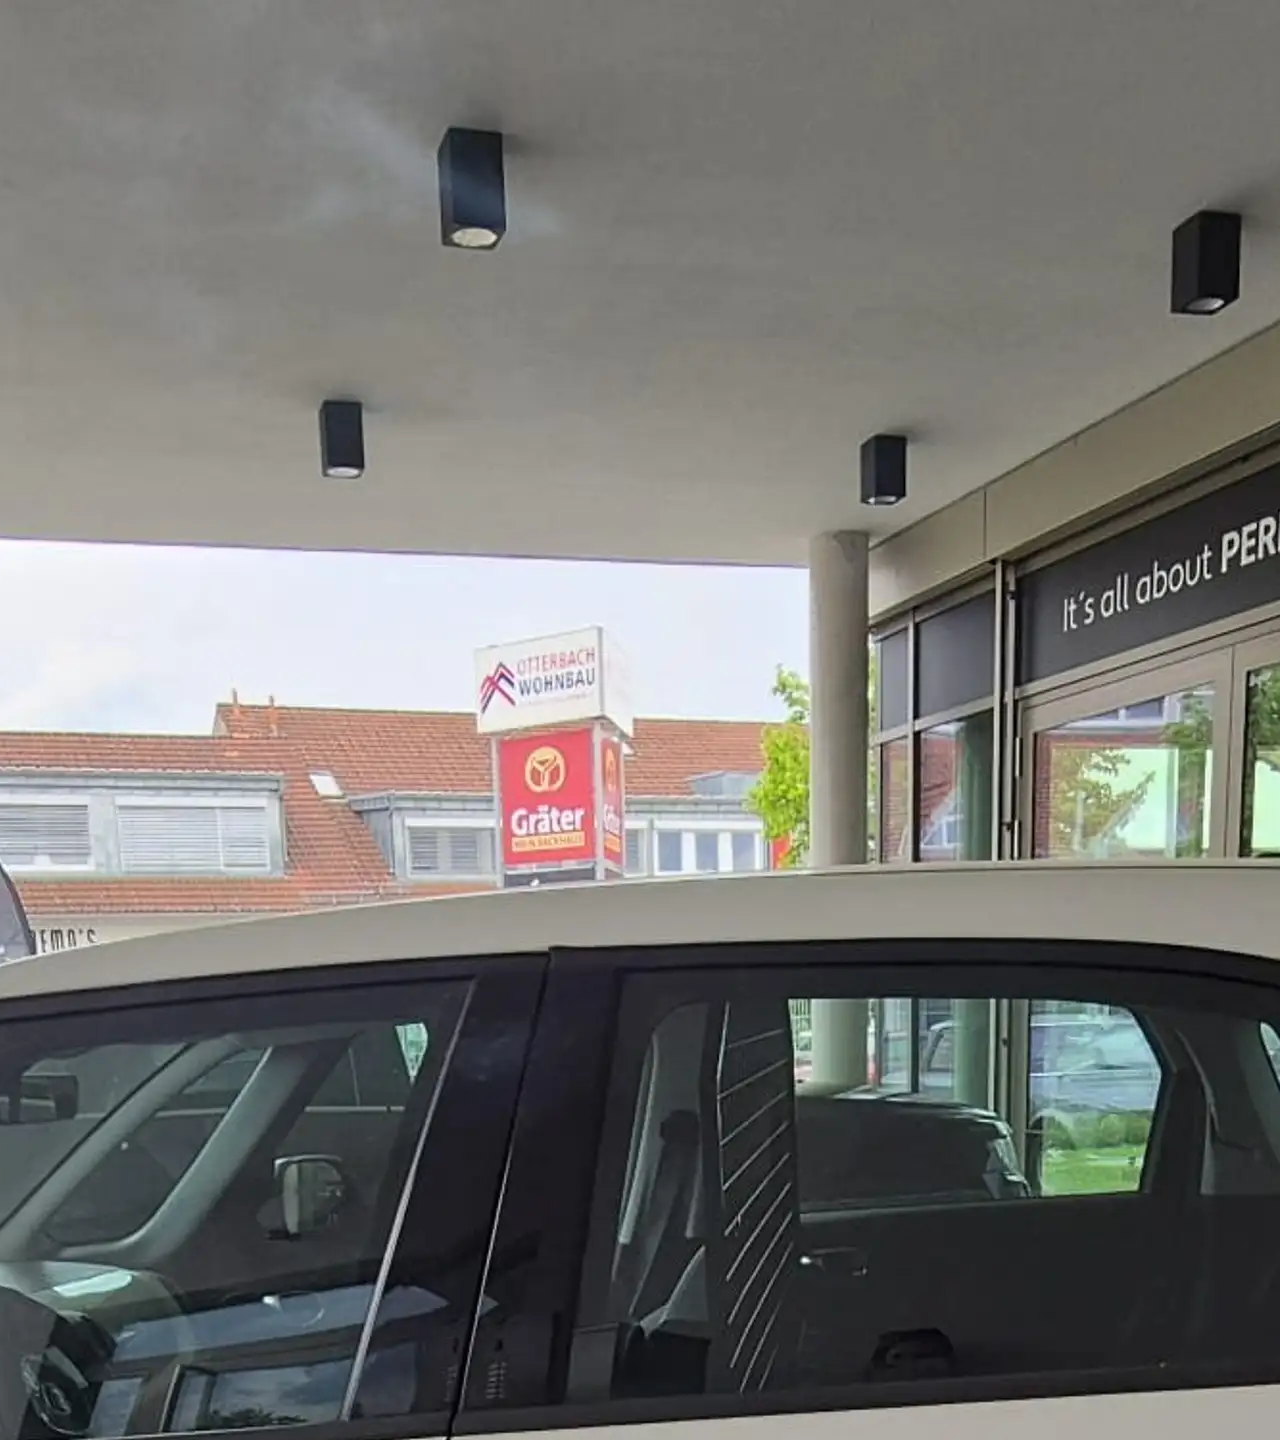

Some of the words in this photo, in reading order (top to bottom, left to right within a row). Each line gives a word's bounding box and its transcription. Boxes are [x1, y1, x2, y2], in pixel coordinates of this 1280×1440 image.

[1100, 572, 1130, 619] all
[1135, 543, 1214, 605] about
[517, 646, 596, 676] OTTERBACH
[519, 668, 596, 696] WOHNBAU
[510, 804, 585, 836] Gräter
